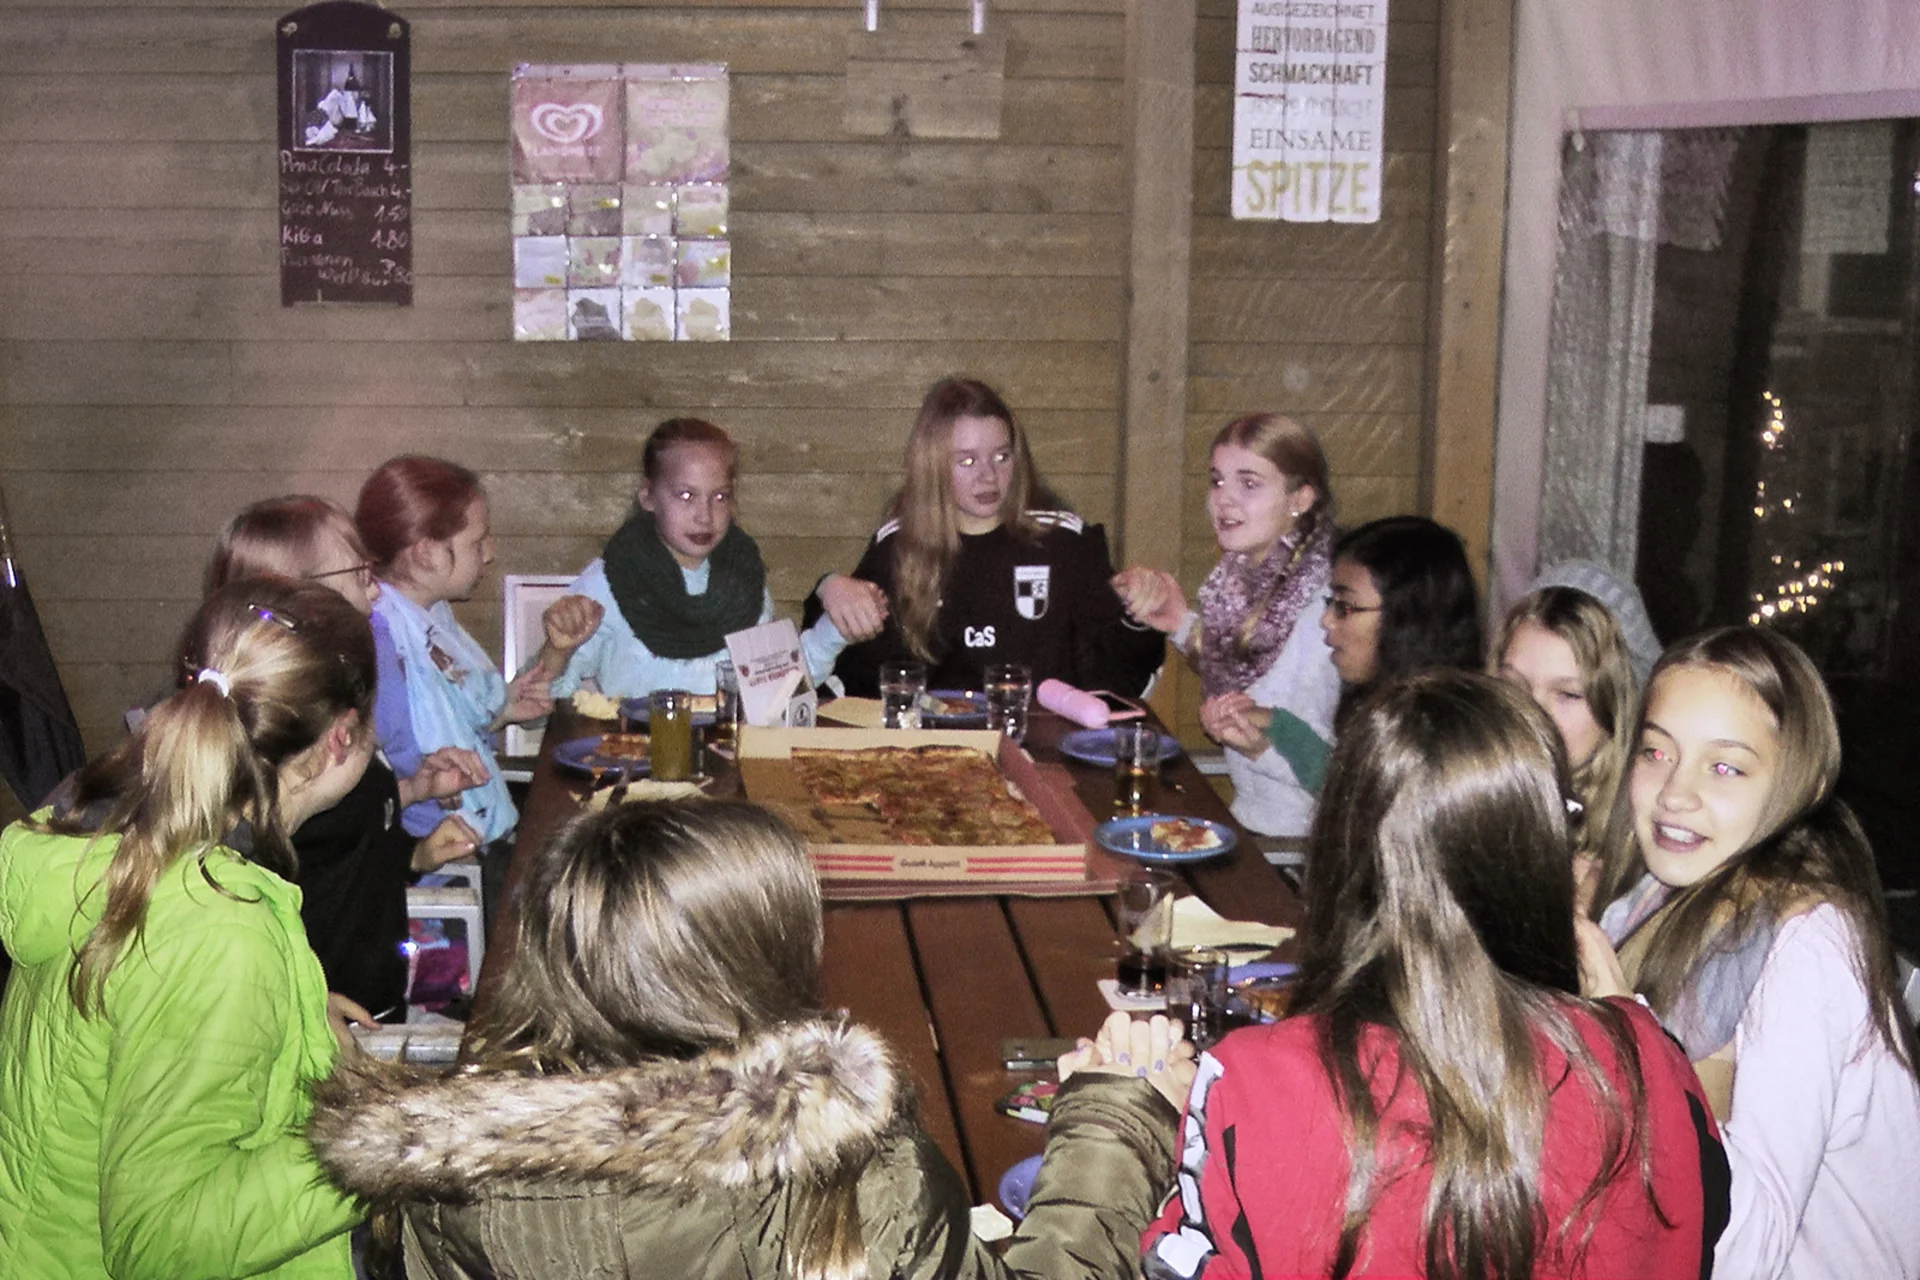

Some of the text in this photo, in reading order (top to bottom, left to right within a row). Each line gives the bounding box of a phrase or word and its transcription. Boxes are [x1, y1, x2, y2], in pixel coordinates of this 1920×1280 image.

[1251, 25, 1376, 54] HERVORRAGEND
[1248, 61, 1373, 85] SCHMACKHAFT
[1250, 128, 1372, 151] EINSAME
[1245, 159, 1371, 214] SPITZE
[964, 625, 996, 648] CaS
